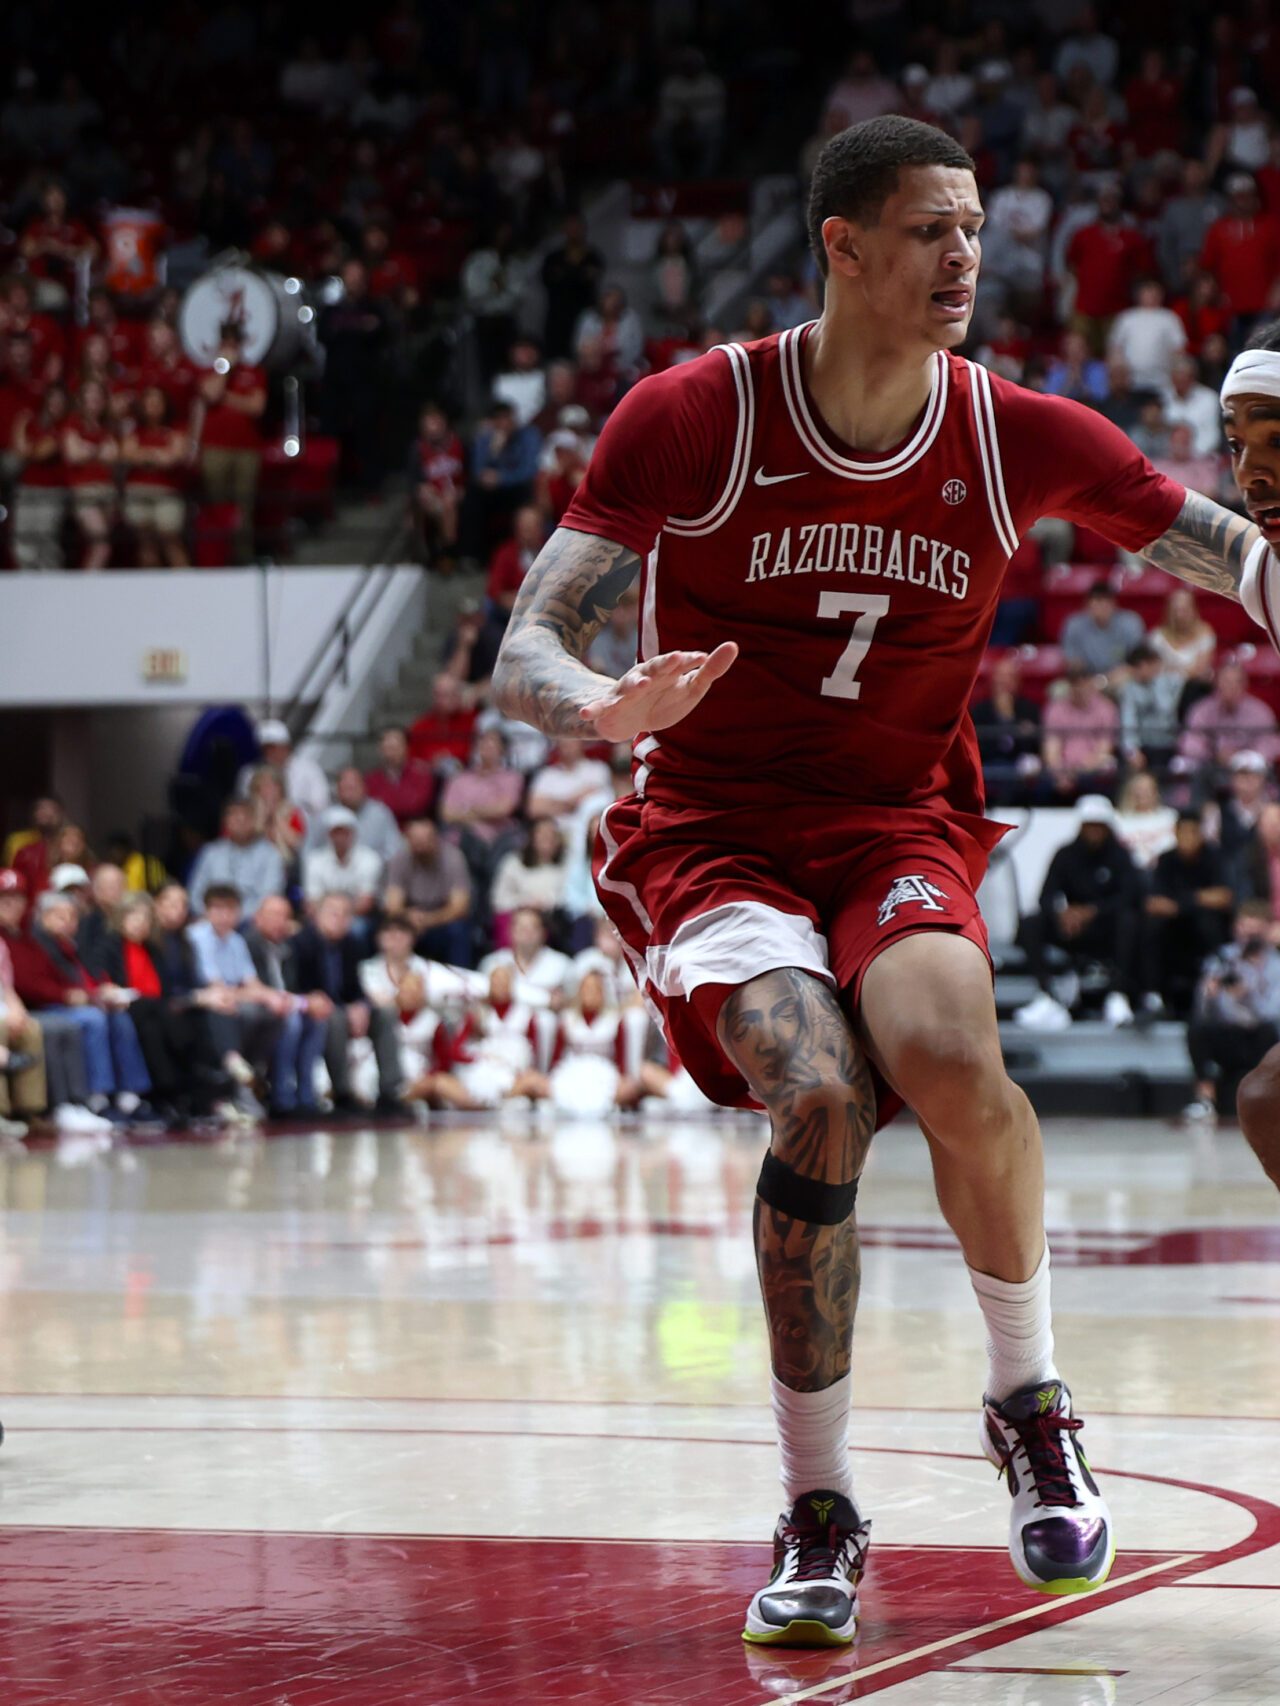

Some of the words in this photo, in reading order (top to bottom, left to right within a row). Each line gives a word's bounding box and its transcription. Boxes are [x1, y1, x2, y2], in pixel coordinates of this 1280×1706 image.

[943, 480, 966, 503] SEC
[745, 523, 970, 600] RAZORBACKS
[816, 591, 890, 700] 7
